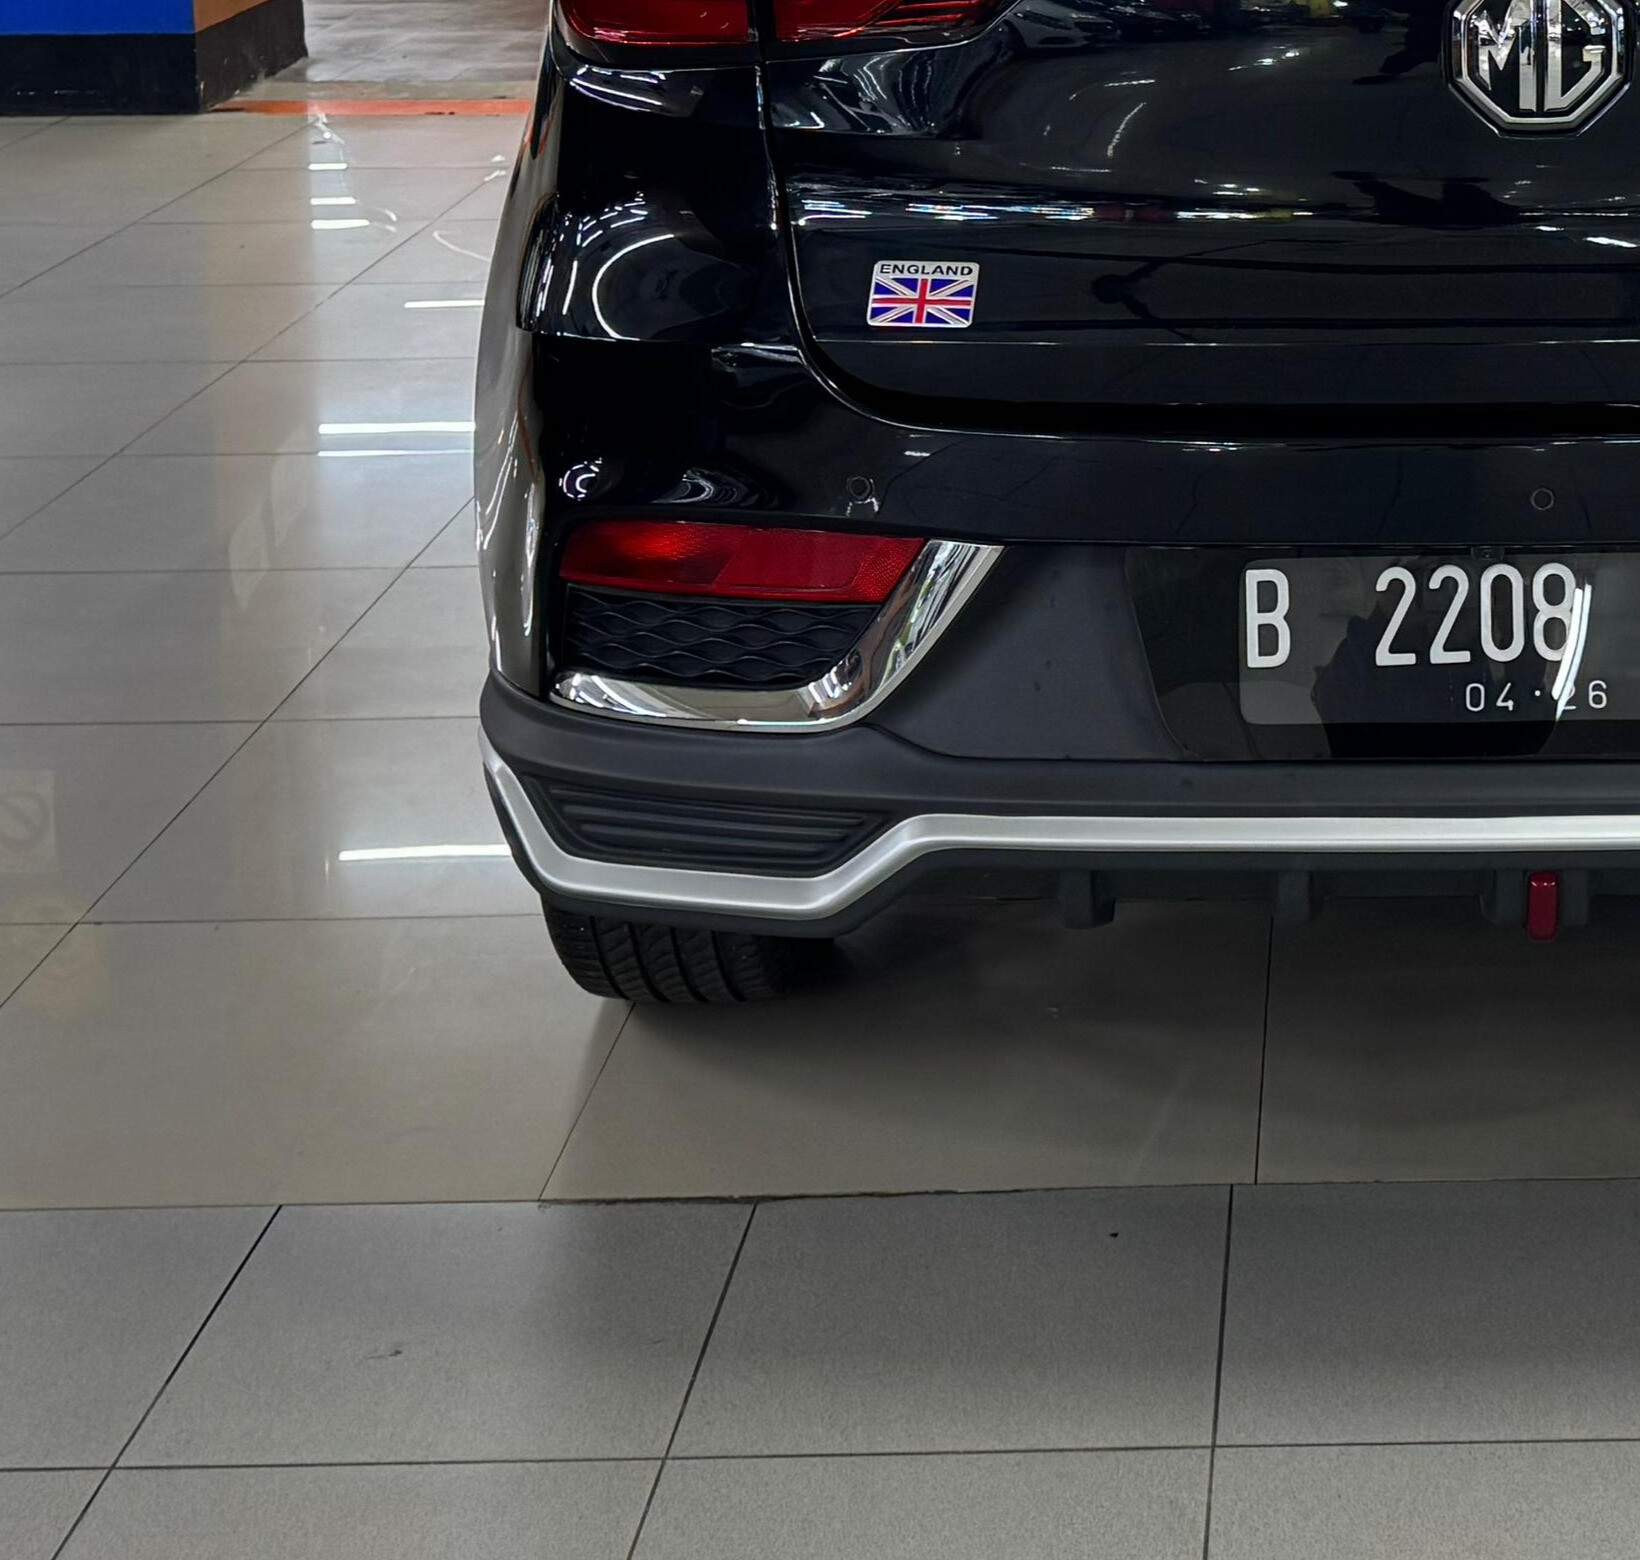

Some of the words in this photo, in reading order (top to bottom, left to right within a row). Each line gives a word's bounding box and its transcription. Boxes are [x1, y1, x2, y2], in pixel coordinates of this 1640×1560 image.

[880, 263, 973, 276] ENGLAND
[1245, 568, 1292, 669] B
[1374, 562, 1578, 668] 2208
